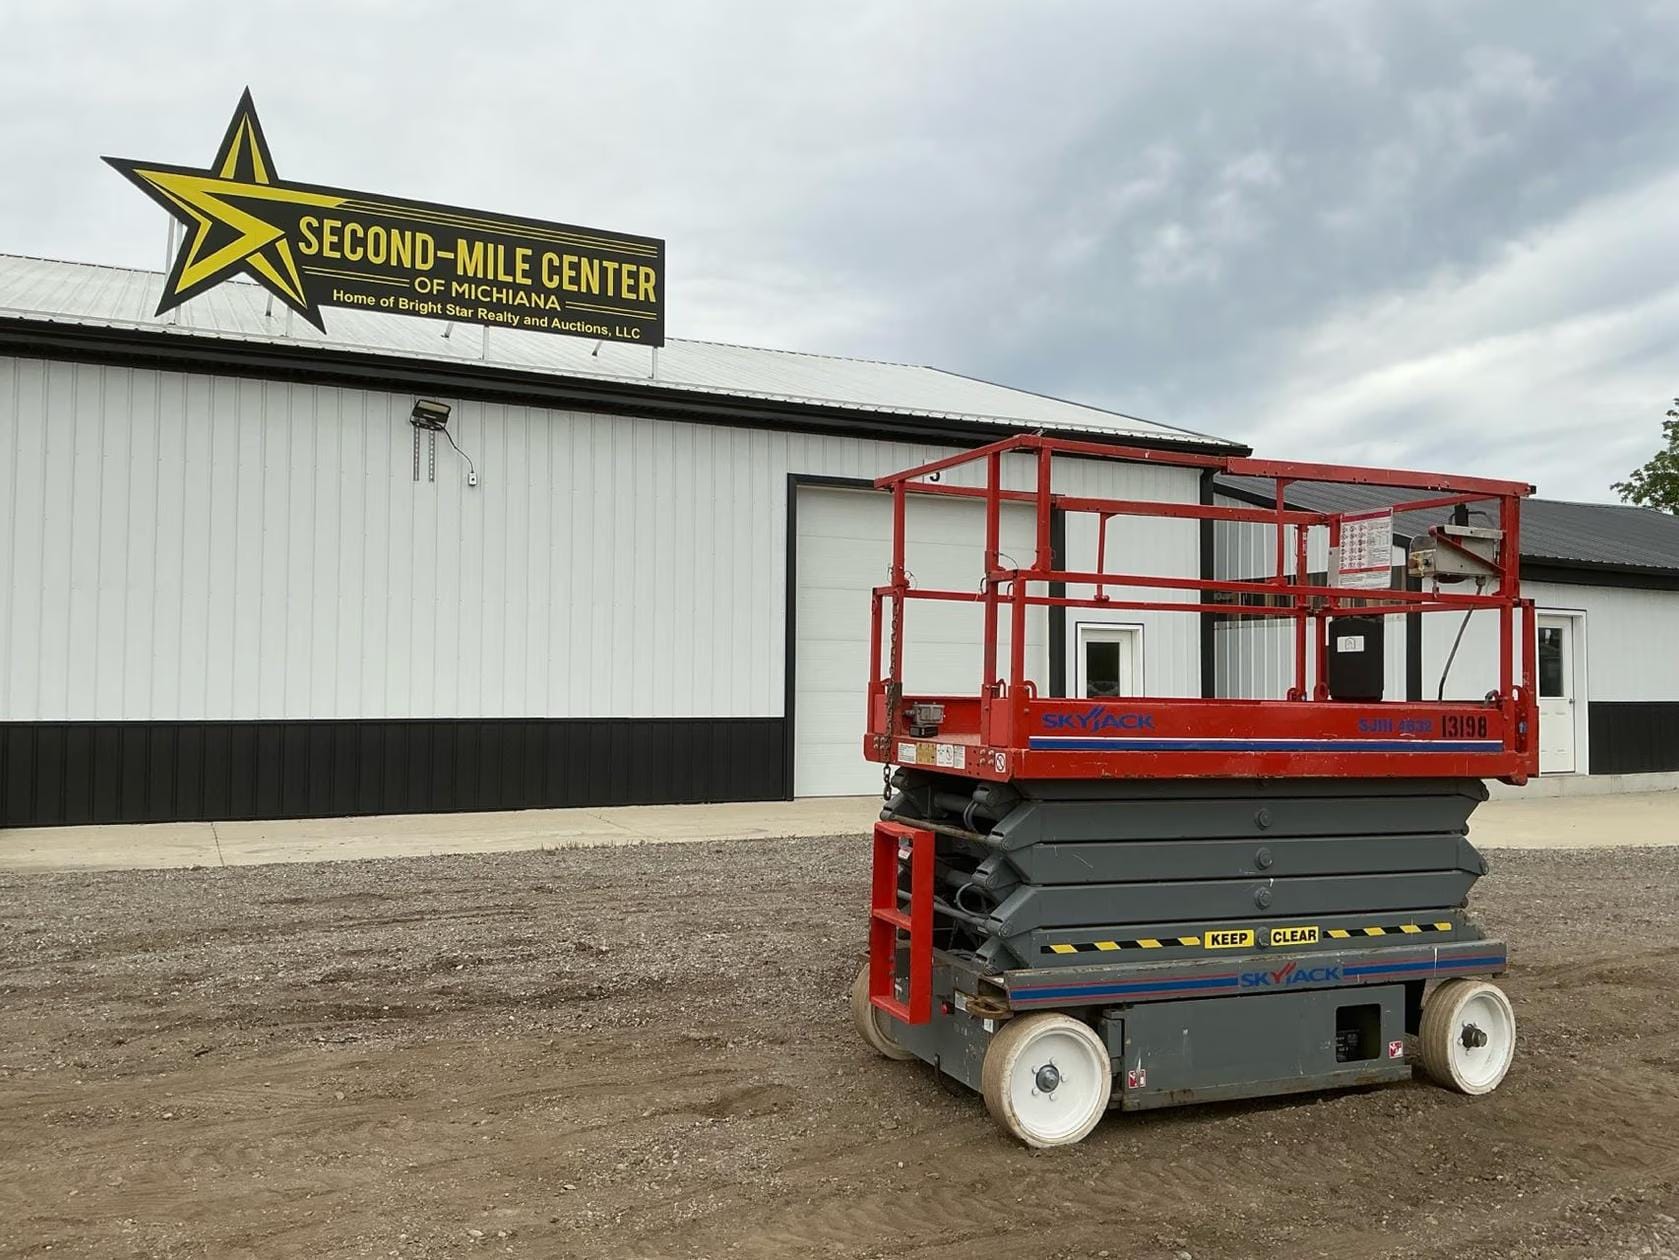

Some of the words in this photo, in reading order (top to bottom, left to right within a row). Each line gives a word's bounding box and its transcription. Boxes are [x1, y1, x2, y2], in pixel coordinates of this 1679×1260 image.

[298, 215, 533, 286] SECOND-MILE
[540, 251, 657, 303] CENTER
[414, 276, 445, 295] OF
[451, 282, 562, 312] MICHIANA
[333, 288, 376, 307] Home
[380, 293, 395, 309] of
[399, 297, 443, 317] Bright
[446, 304, 474, 318] Star
[478, 307, 520, 327] Realty
[523, 314, 548, 328] and
[551, 318, 612, 338] Auctions,
[615, 326, 642, 340] LLC
[1043, 705, 1154, 731] SKYJACK
[1441, 715, 1487, 738] 13198
[1211, 932, 1248, 946] KEEP
[1273, 929, 1316, 943] CLEAR
[1240, 962, 1339, 987] SKYJACK
